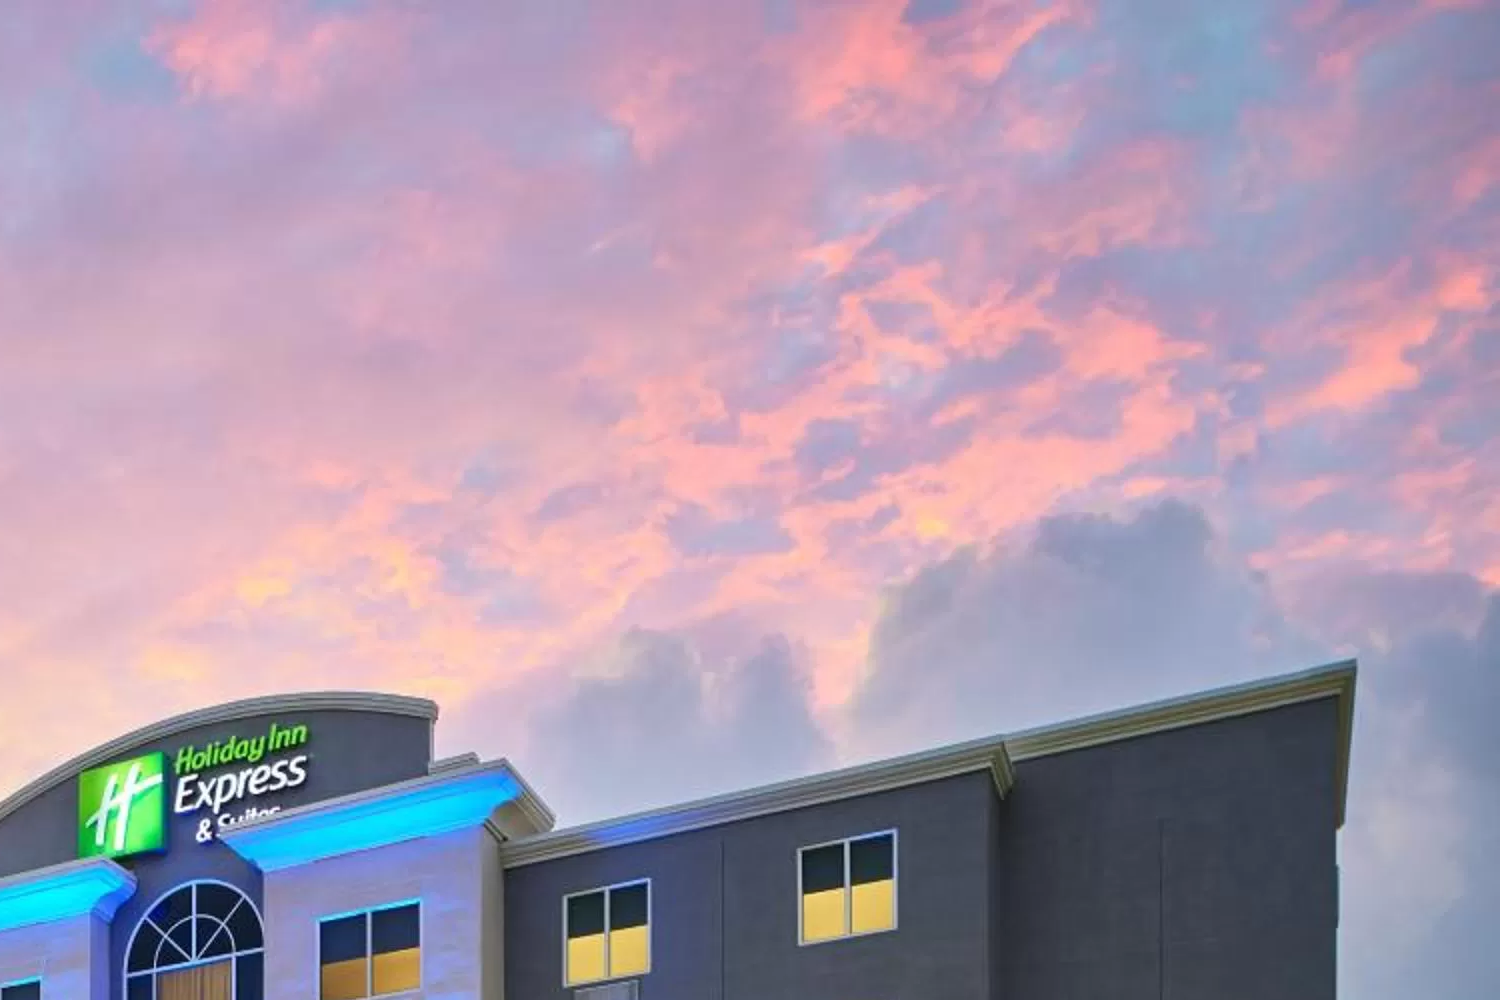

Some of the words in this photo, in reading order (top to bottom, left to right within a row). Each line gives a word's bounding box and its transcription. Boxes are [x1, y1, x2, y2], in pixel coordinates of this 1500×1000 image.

[175, 735, 265, 774] Holiday
[268, 723, 307, 751] Inn
[174, 755, 307, 814] Express
[195, 818, 212, 842] &
